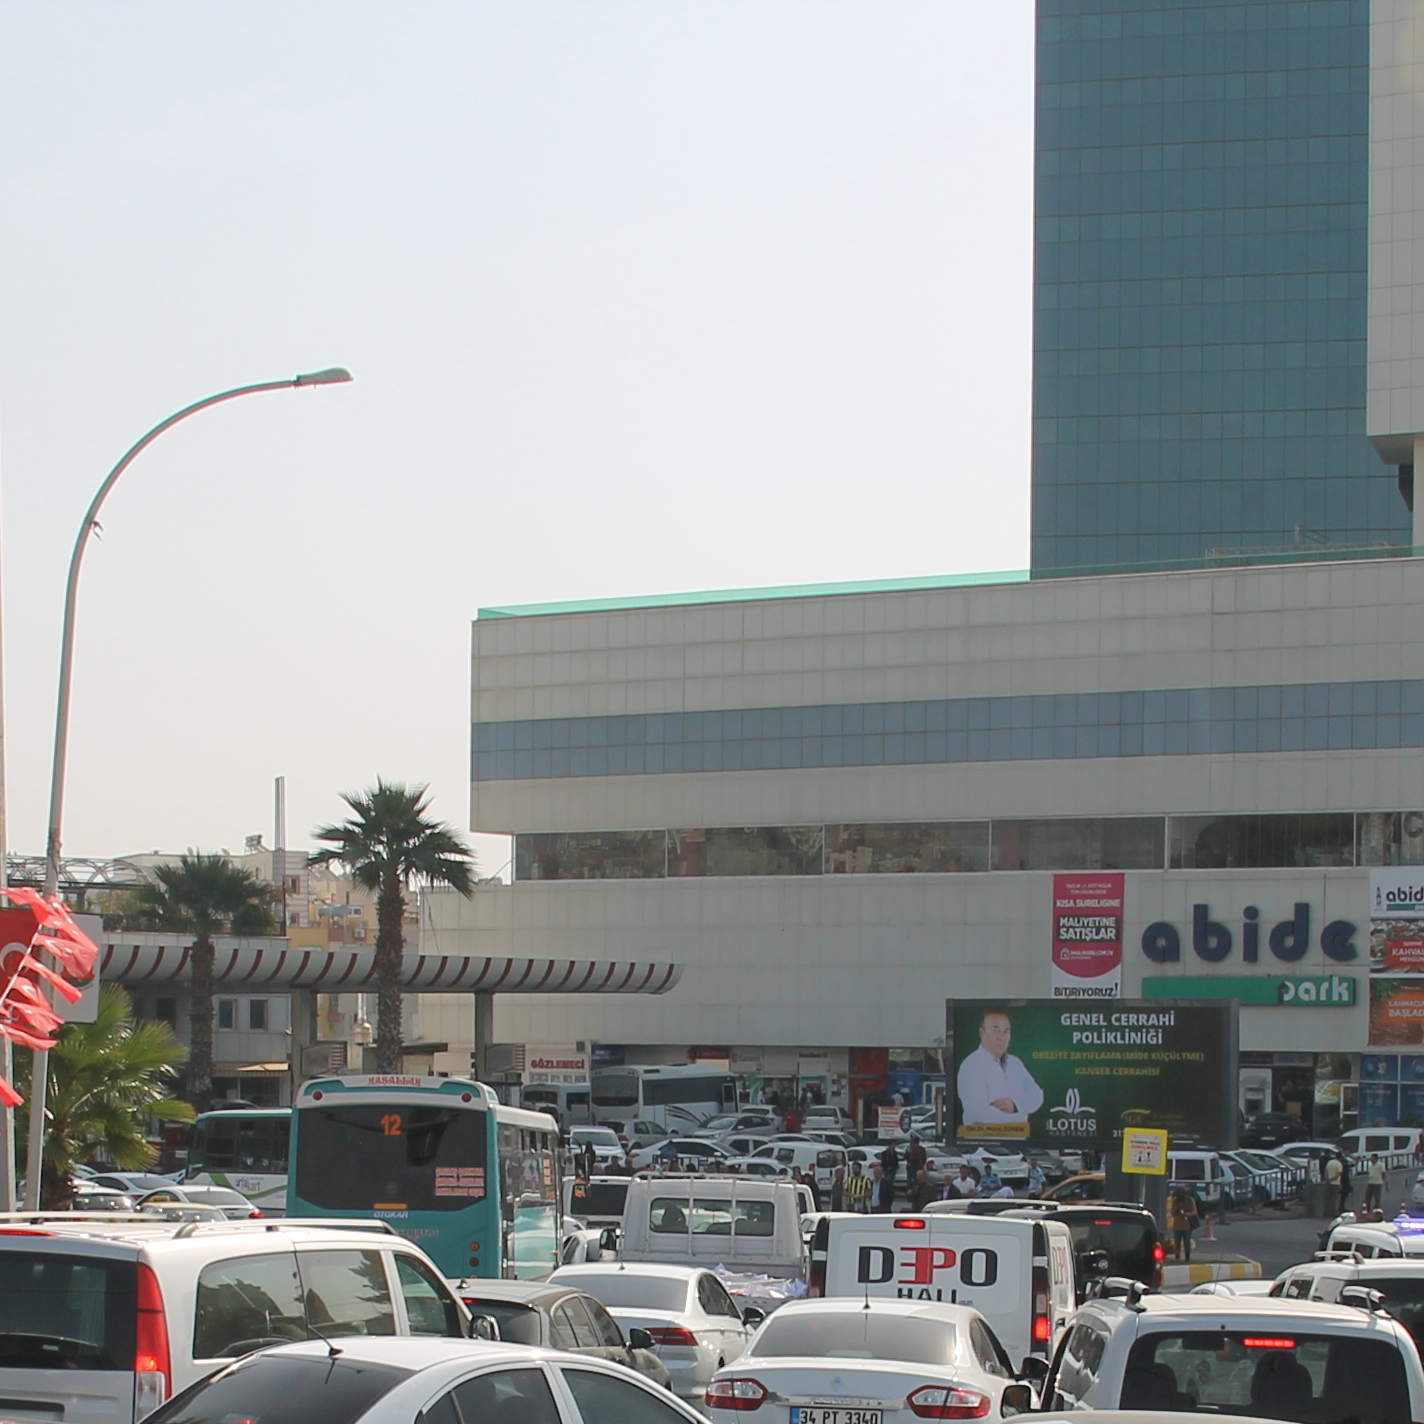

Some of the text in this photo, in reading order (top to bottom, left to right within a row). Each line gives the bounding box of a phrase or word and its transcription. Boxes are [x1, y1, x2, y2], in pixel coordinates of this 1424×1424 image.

[1059, 916, 1116, 927] MALİYETİNE
[1059, 928, 1115, 941] SATIŞLAR
[1141, 903, 1358, 963] abide
[1054, 982, 1118, 998] BİTİRİYORUZ!
[1060, 1010, 1175, 1027] GENEL CERRAHİ
[1072, 1028, 1163, 1045] POLİKLİNİĞİ
[1075, 1066, 1160, 1076] KANSER CERRAHİSİ
[380, 1114, 402, 1136] 12
[1049, 1118, 1097, 1132] LOTUS
[373, 1211, 409, 1219] OTOKAR
[800, 1410, 816, 1424] 34
